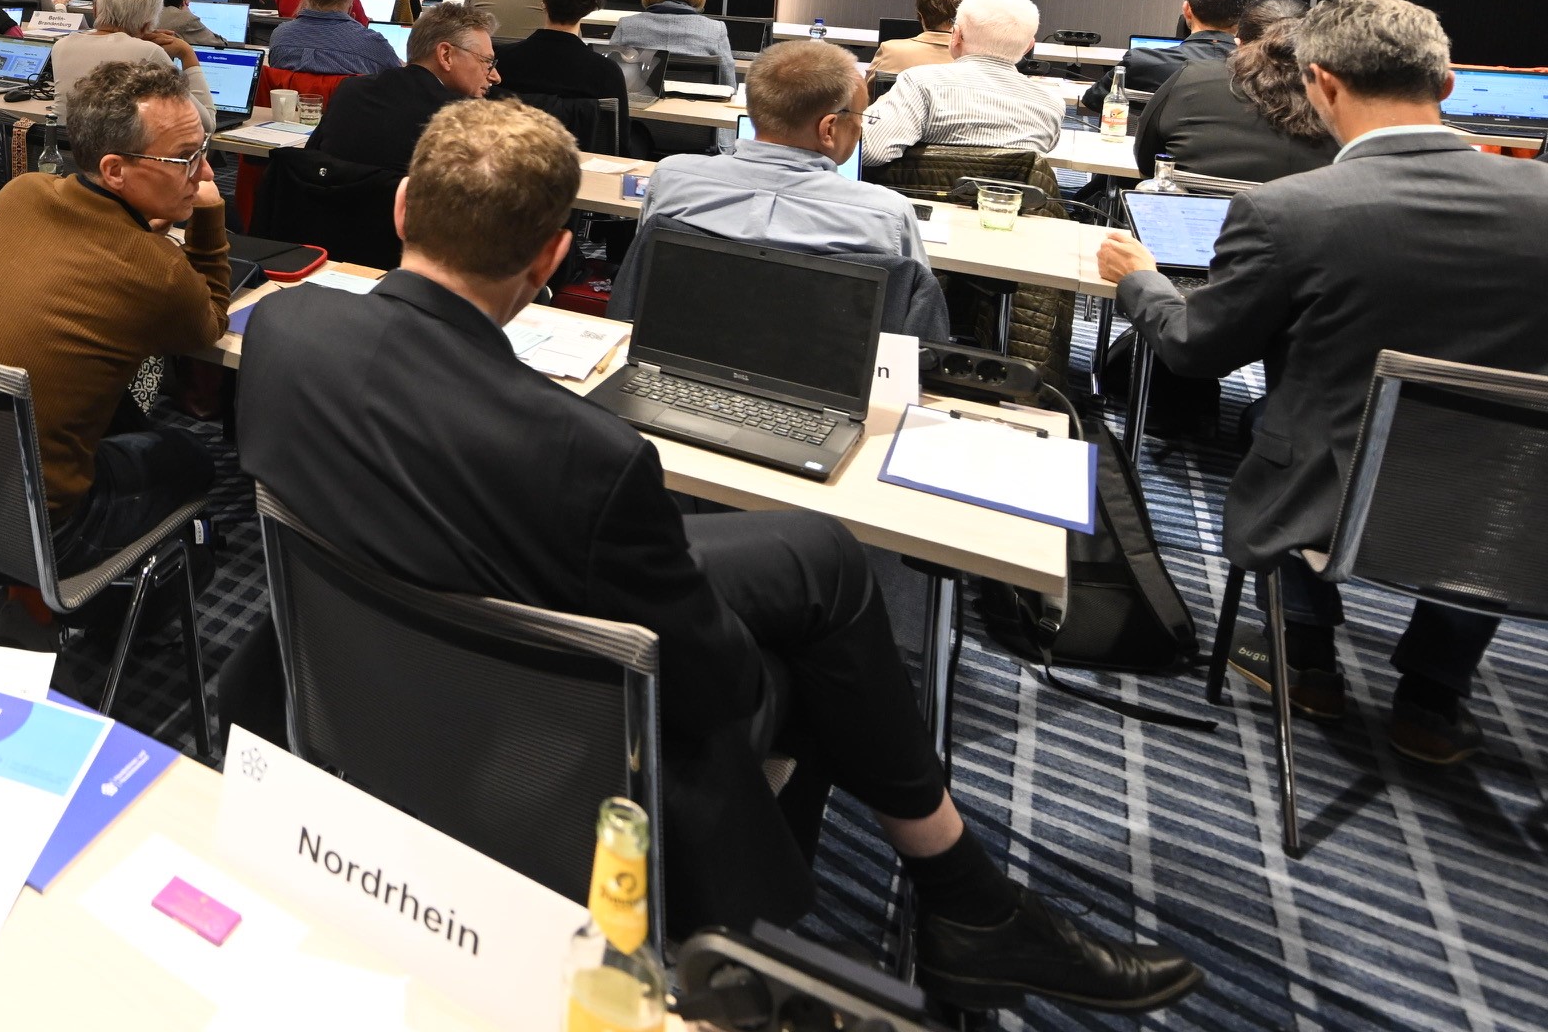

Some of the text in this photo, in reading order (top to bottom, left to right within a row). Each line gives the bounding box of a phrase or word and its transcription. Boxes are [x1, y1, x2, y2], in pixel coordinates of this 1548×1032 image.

[48, 14, 66, 22] Berlin-
[37, 19, 73, 28] Brandenburg
[298, 826, 480, 956] Nordrhein
